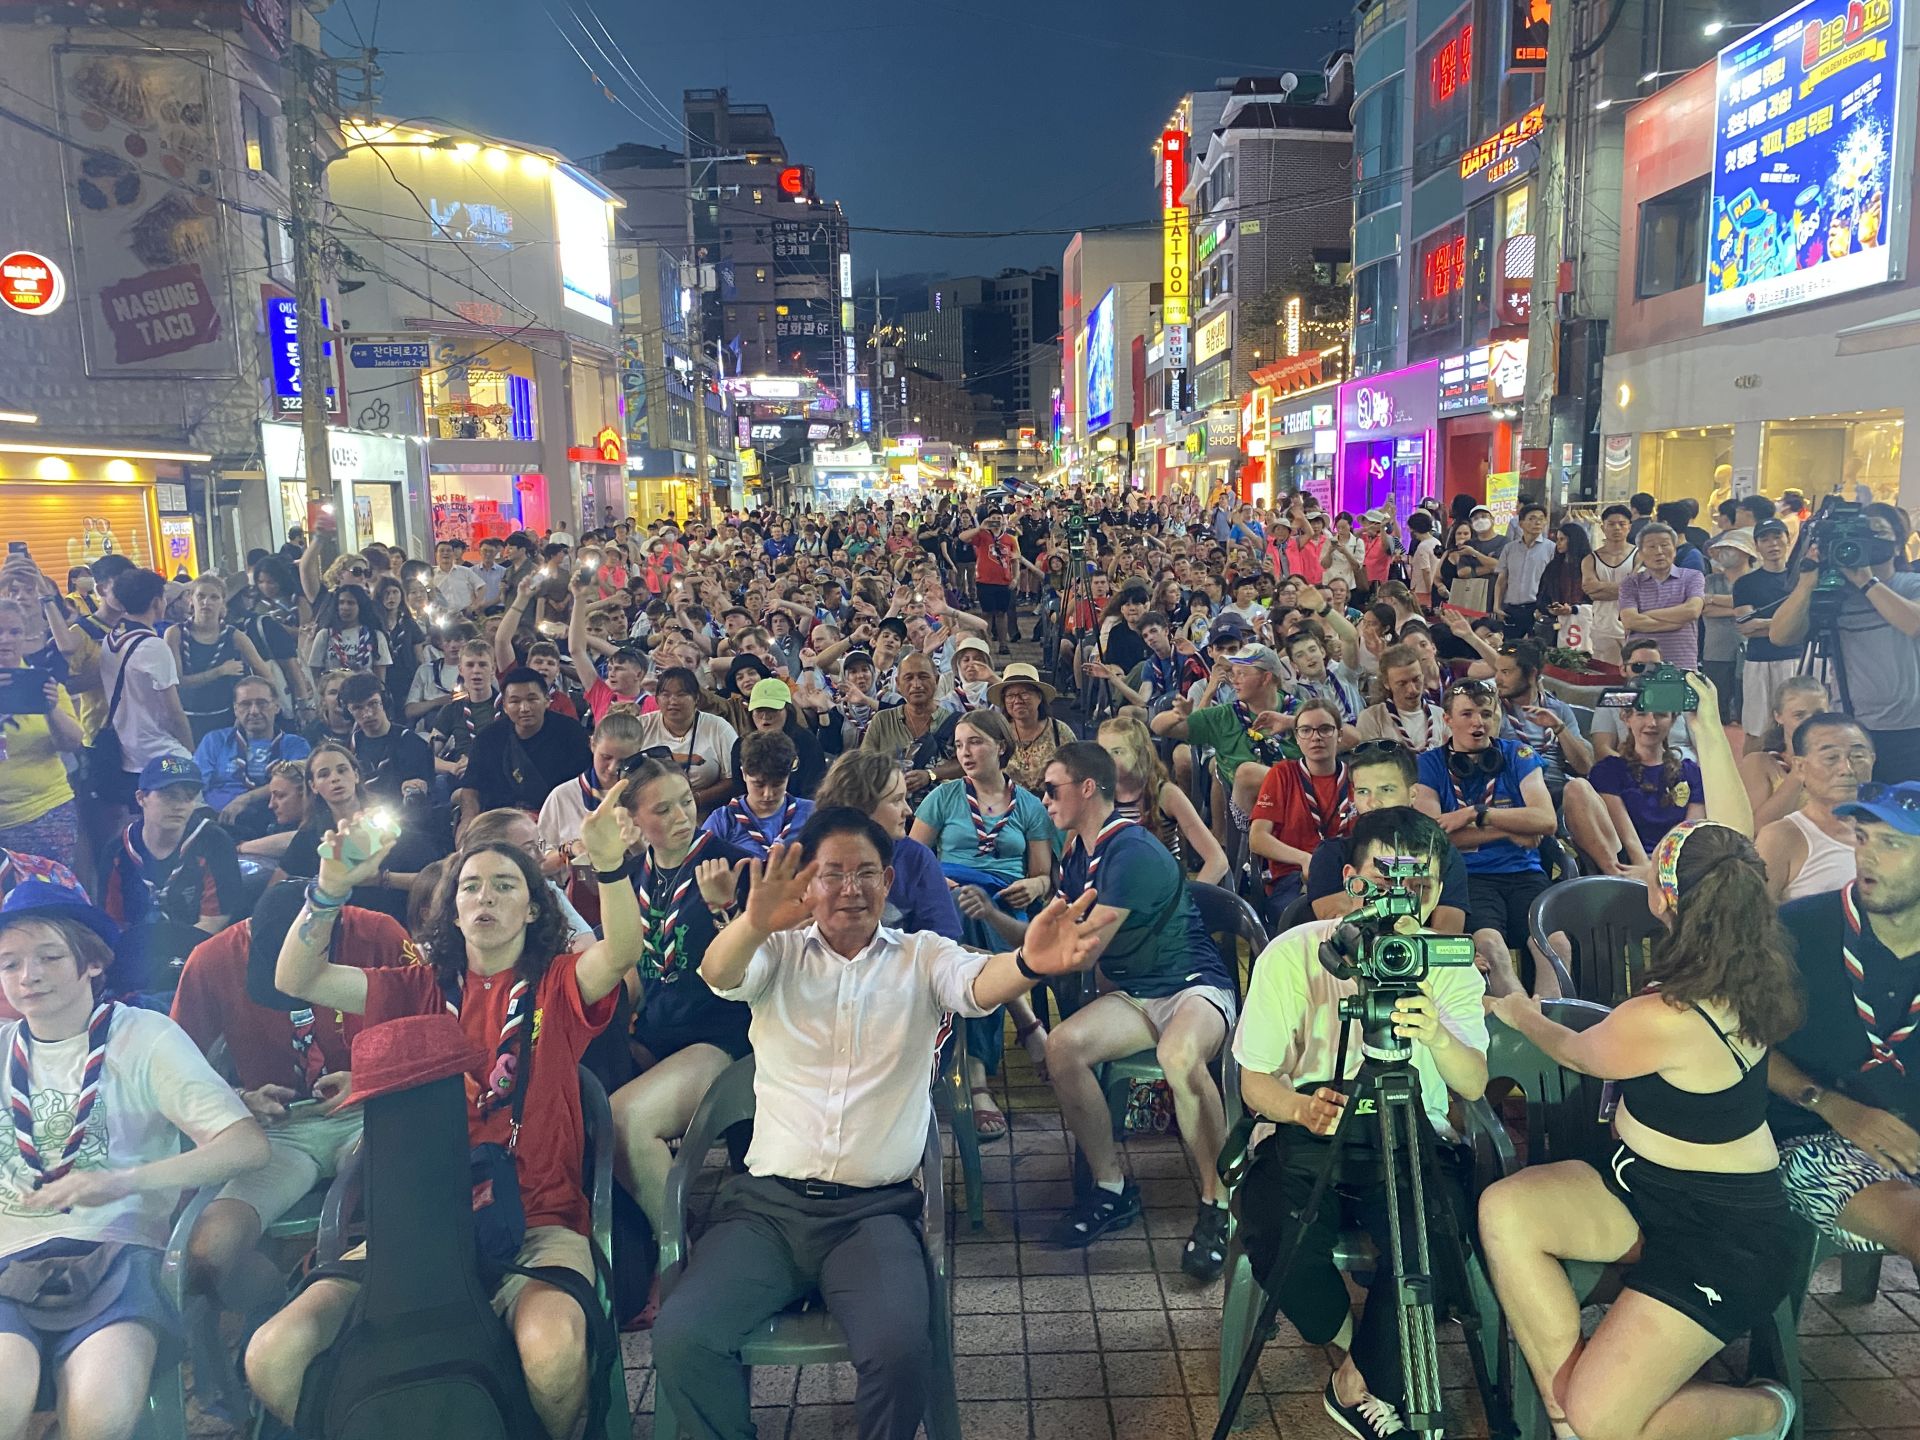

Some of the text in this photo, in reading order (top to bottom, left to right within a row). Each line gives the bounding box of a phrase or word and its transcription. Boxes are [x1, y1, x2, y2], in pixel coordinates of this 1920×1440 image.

[1170, 210, 1183, 293] TATTOO
[112, 281, 200, 322] NASUNG
[136, 313, 196, 346] TACO
[816, 322, 829, 336] 6F
[373, 346, 428, 358] 잔다리로2길
[374, 359, 411, 367] Jandari-ro
[1211, 425, 1236, 434] VAPE
[1209, 436, 1236, 446] SHOP
[1566, 624, 1582, 647] S
